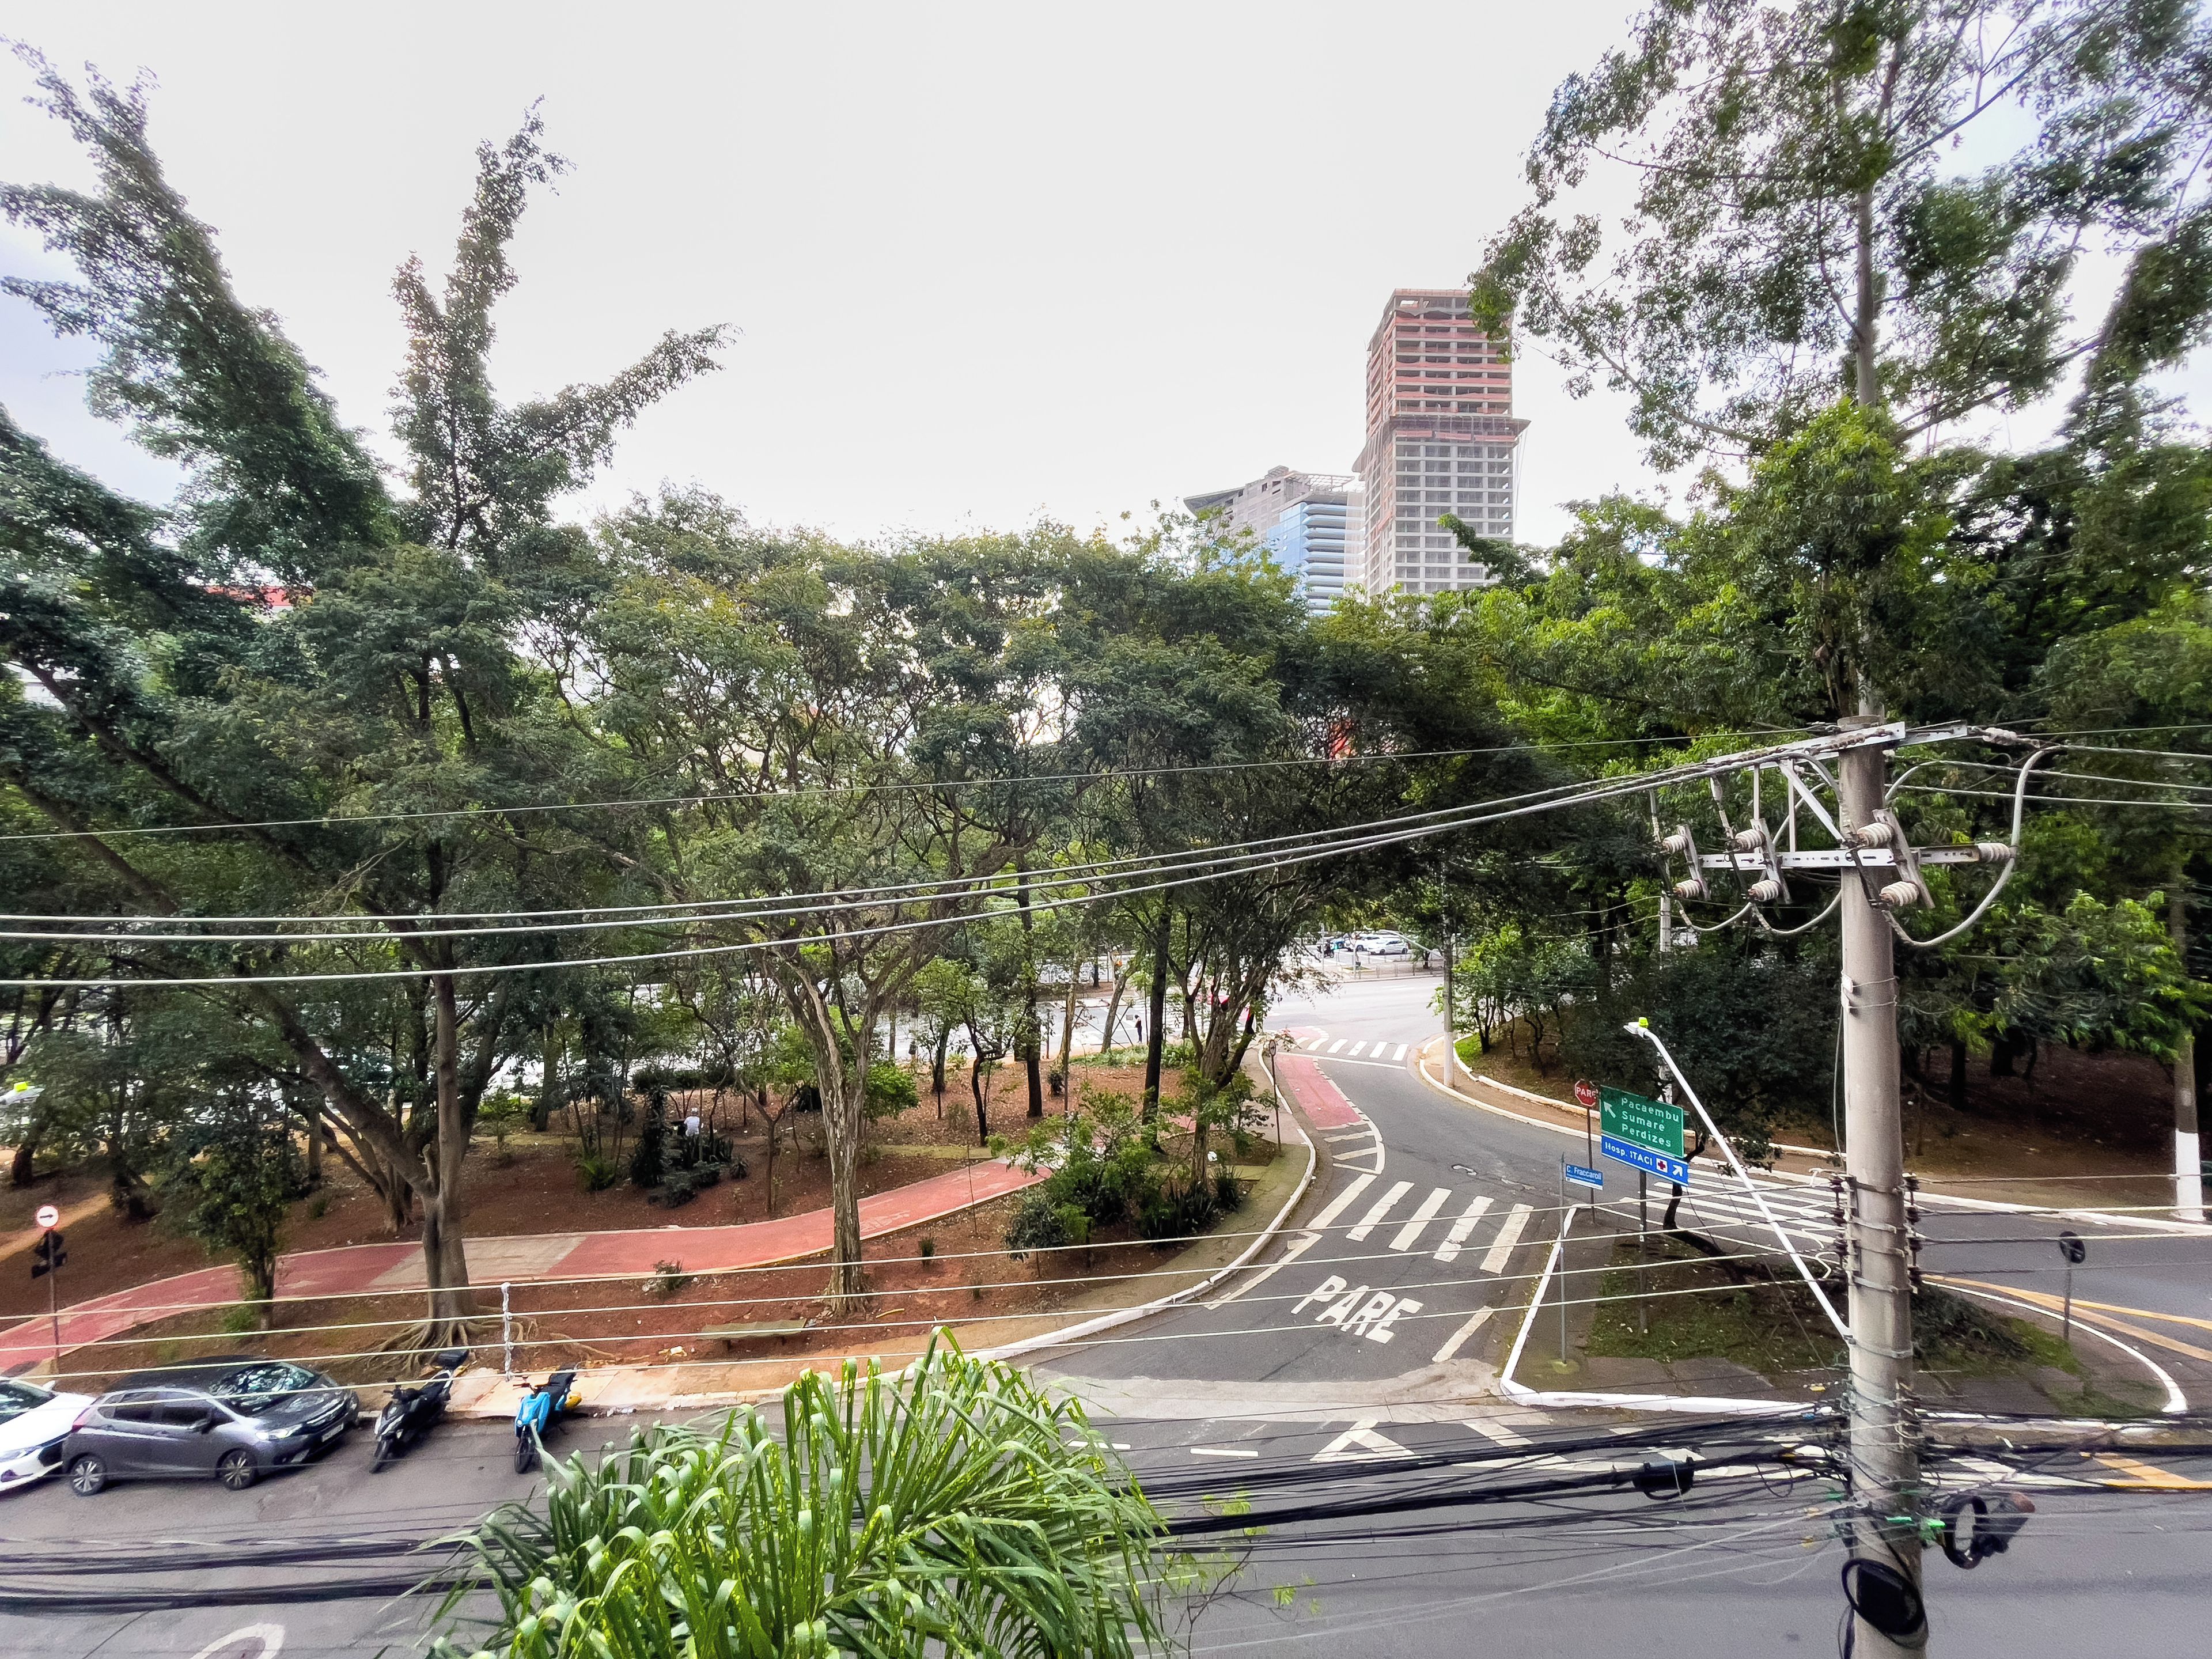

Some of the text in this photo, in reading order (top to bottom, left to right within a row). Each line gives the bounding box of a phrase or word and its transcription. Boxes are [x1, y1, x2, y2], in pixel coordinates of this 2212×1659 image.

[1621, 1097, 1679, 1122] Pacaembu
[1622, 1111, 1665, 1131] Sumaré
[1622, 1123, 1671, 1147] Perdizes
[1605, 1142, 1653, 1165] Hosp. ITACI
[1290, 1275, 1424, 1344] PARE
